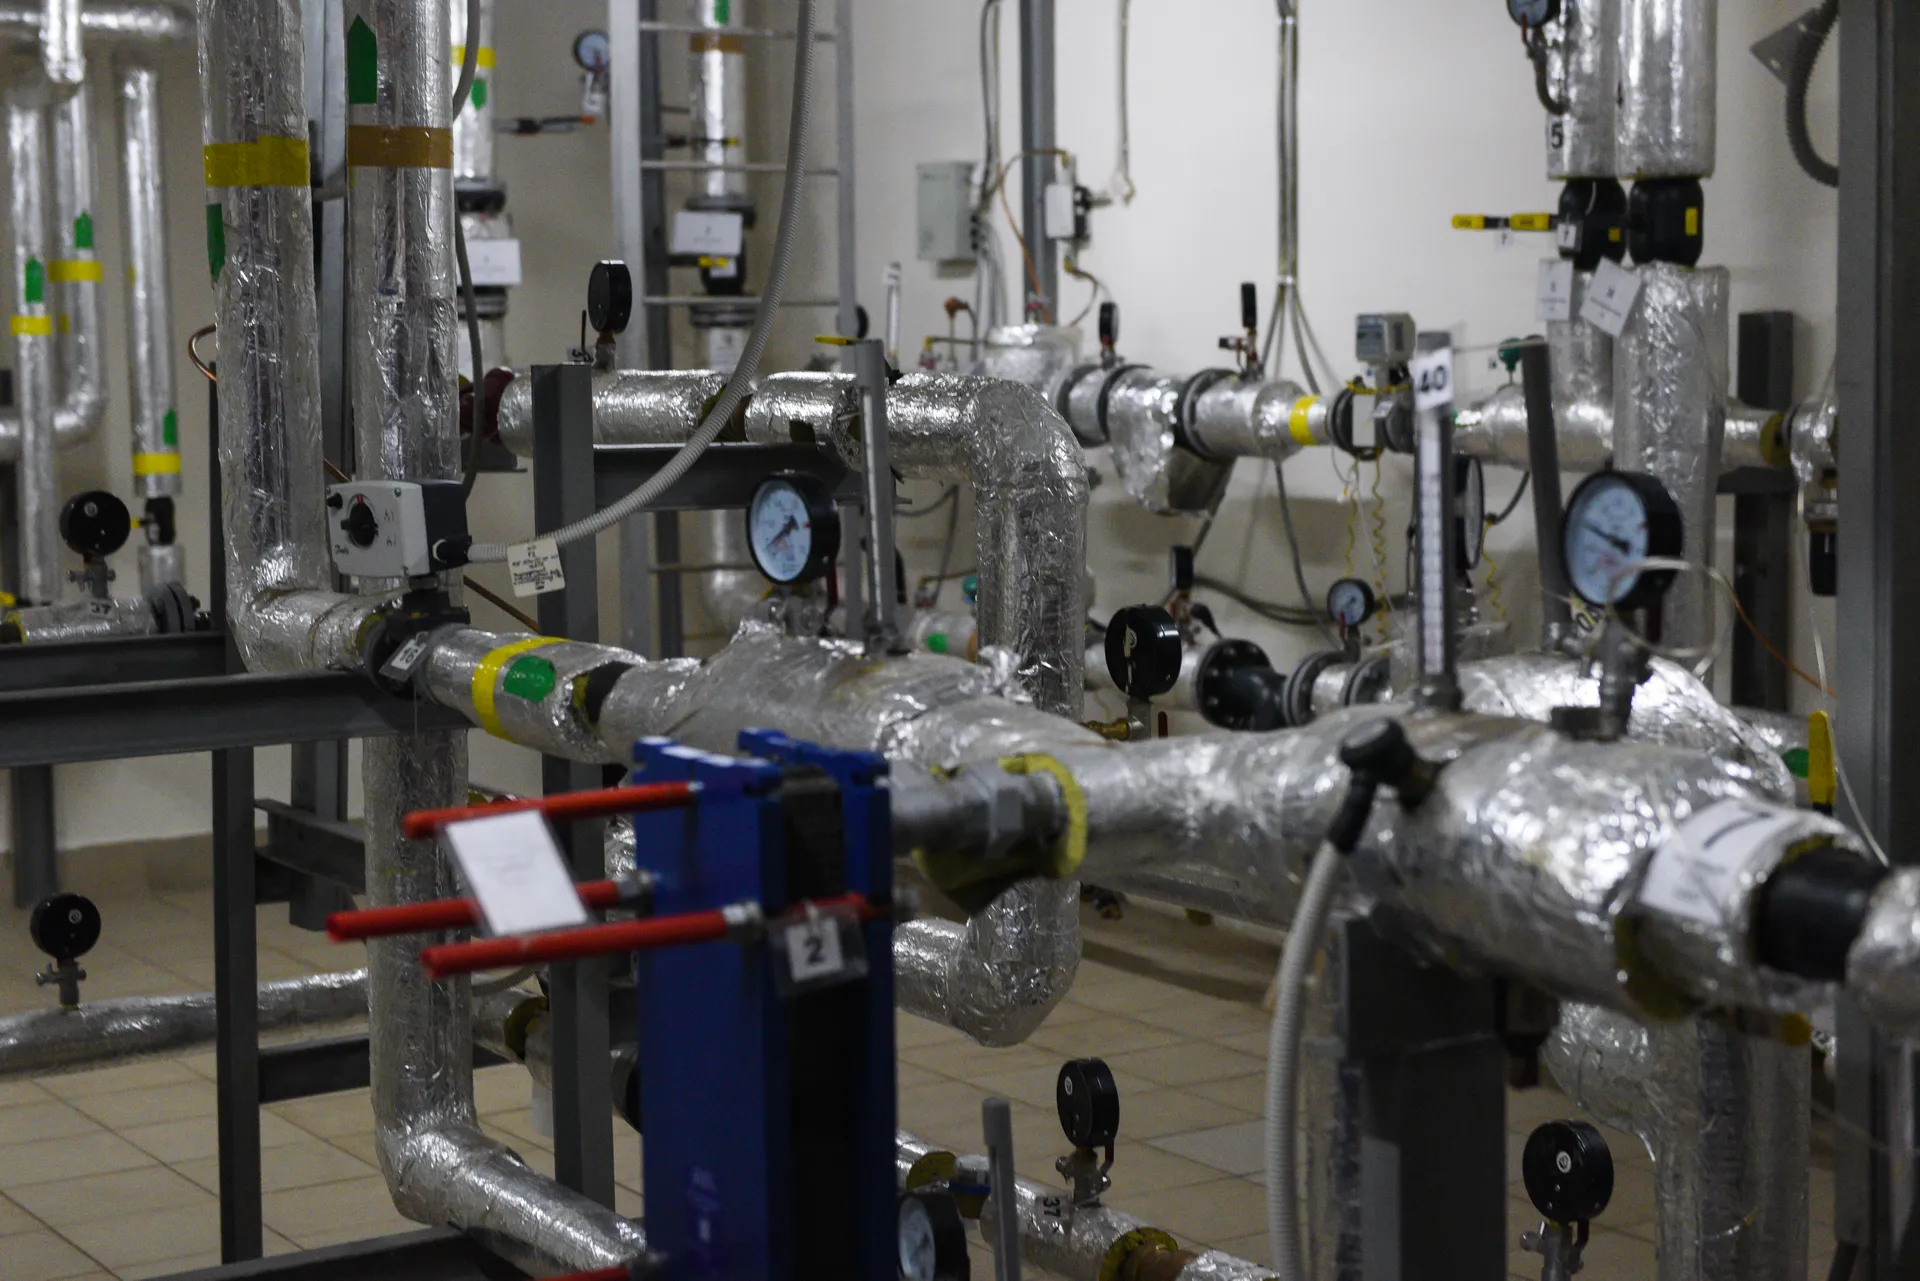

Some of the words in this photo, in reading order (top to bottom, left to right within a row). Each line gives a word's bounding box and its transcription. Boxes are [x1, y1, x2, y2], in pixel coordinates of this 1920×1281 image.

[1551, 121, 1563, 149] 5
[804, 936, 826, 965] 2
[1043, 1197, 1061, 1217] 37
